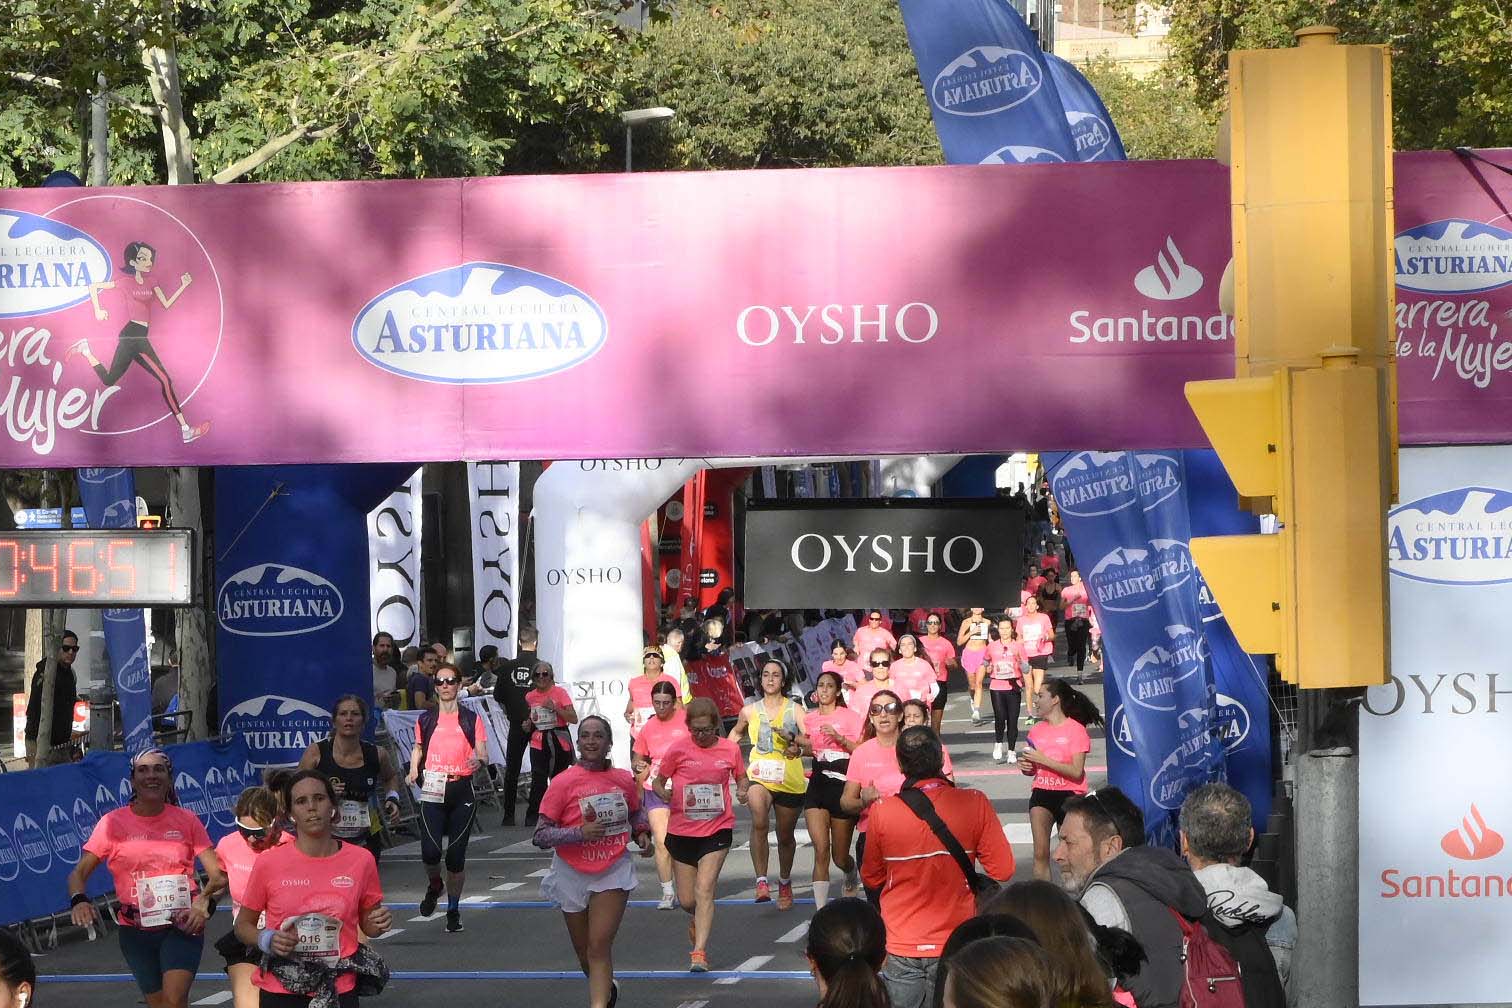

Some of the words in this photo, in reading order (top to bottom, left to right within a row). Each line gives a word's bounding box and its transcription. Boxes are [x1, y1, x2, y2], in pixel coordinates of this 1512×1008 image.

[11, 245, 88, 258] LECHERA
[736, 302, 939, 347] OYSHO
[1070, 310, 1236, 345] Santand
[1394, 300, 1490, 329] arrera
[372, 309, 586, 355] ASTURIANA
[1418, 329, 1436, 357] la
[1432, 323, 1512, 389] Muje
[1415, 521, 1484, 532] CENTRAL
[791, 533, 984, 574] OYSHO
[546, 566, 622, 586] OYSHO
[221, 593, 335, 620] ASTURIANA
[516, 671, 530, 680] BP
[1361, 672, 1512, 716] OYSH
[1380, 869, 1512, 898] Santan
[156, 894, 175, 903] 016
[299, 934, 321, 944] 016
